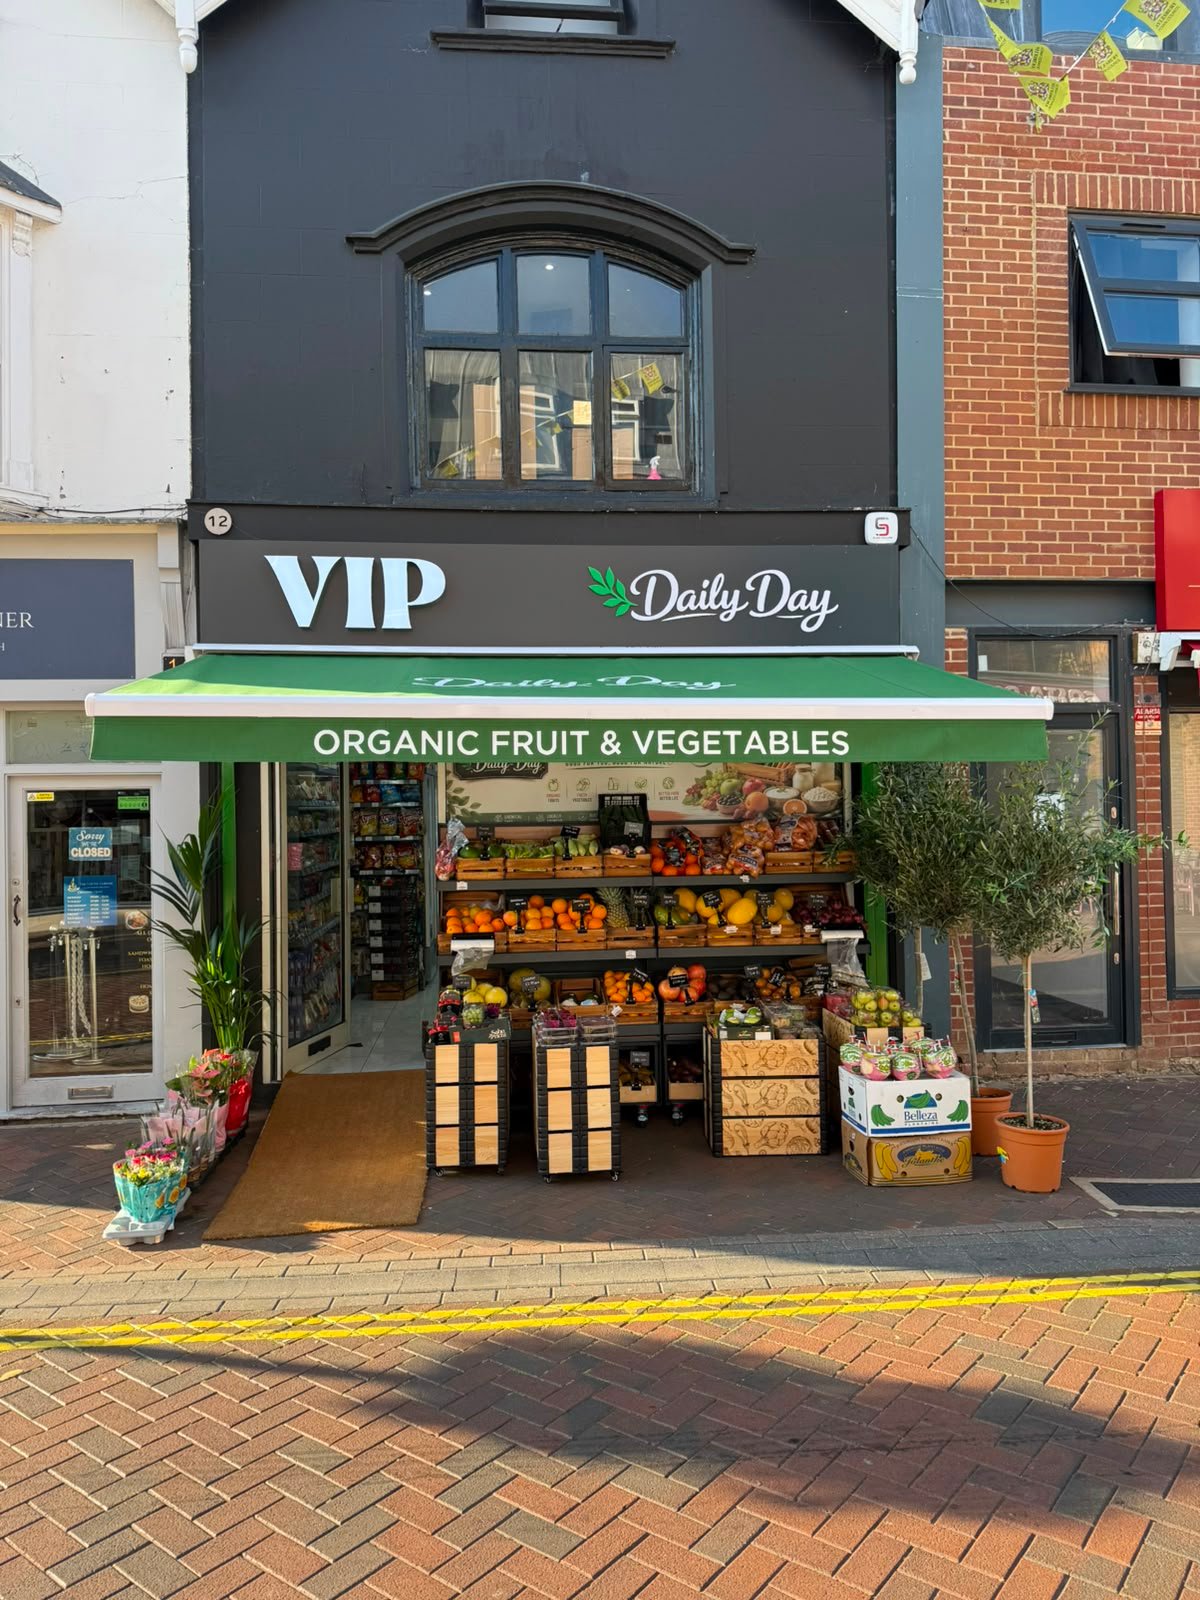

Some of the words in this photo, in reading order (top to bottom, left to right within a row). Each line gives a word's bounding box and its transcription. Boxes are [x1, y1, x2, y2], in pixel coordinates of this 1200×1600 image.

[207, 514, 228, 528] 12
[264, 555, 446, 630] VIP
[629, 569, 749, 623] Daily
[745, 569, 839, 633] Day
[0, 612, 35, 629] ER
[412, 676, 592, 689] Daily
[596, 675, 737, 691] Day
[313, 728, 479, 756] ORGANIC
[491, 729, 589, 756] FRUIT
[600, 729, 621, 756] &
[631, 729, 850, 756] VEGETABLES
[76, 830, 104, 844] Sorry
[71, 848, 111, 858] CLOSED
[904, 1110, 937, 1121] Belleza
